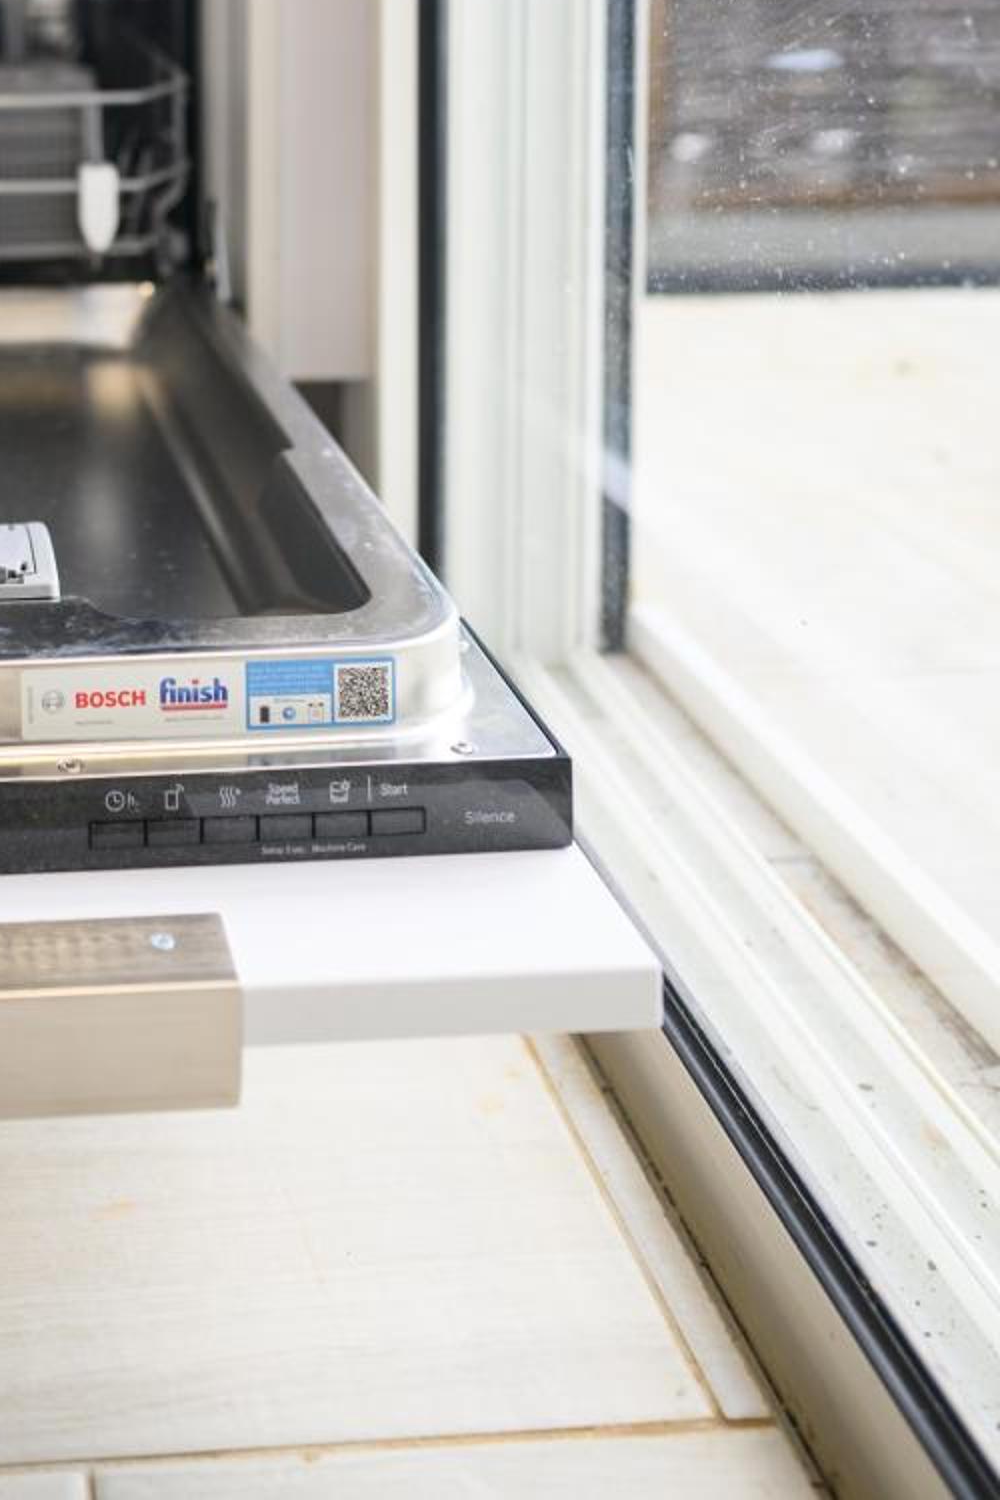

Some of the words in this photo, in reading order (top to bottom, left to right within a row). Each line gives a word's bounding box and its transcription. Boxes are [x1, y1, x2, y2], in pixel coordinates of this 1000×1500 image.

[159, 677, 228, 704] finish
[75, 690, 146, 709] BOSCH
[380, 782, 409, 797] Start
[464, 809, 516, 824] Silence
